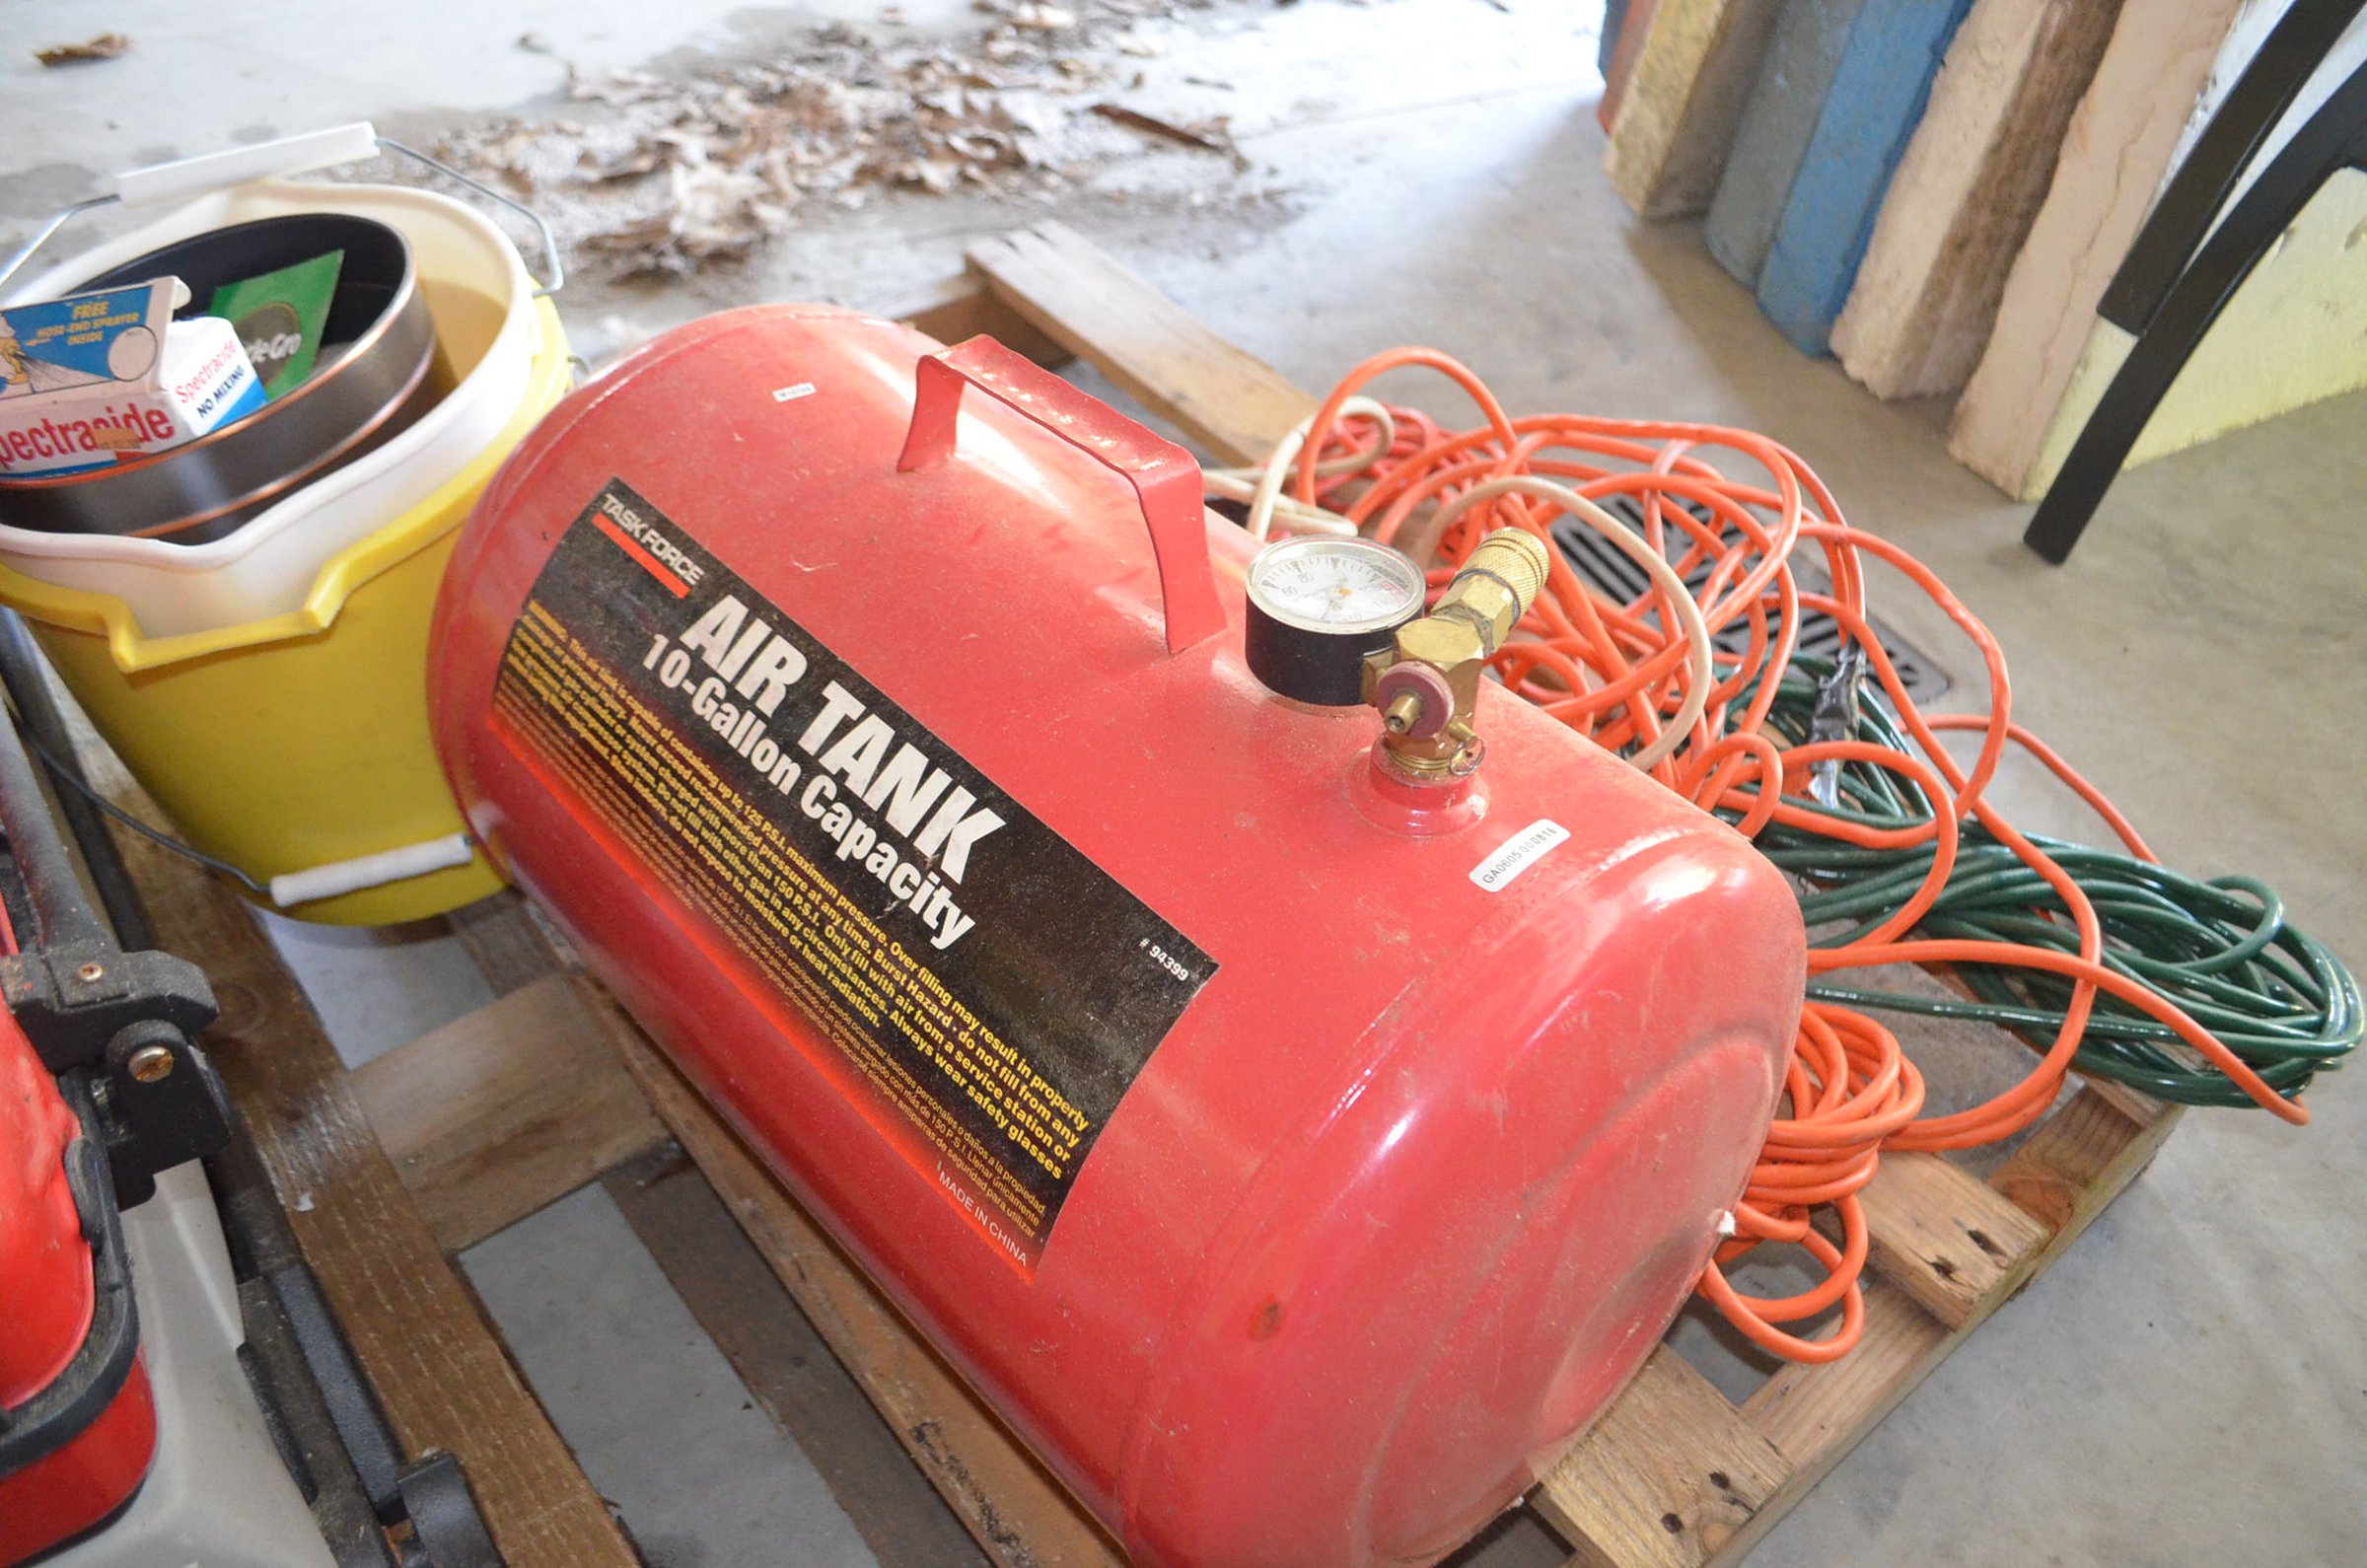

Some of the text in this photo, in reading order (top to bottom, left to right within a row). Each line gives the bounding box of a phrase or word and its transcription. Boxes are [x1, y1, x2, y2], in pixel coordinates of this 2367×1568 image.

[72, 301, 108, 320] FREE
[197, 365, 245, 419] NO MIXING
[601, 492, 705, 586] TASK FORCE
[642, 632, 802, 796] 10-Gallon
[800, 774, 976, 951] Capacity
[680, 594, 808, 719] AIR
[797, 679, 1007, 885] TANK
[668, 812, 683, 832] do
[681, 824, 699, 848] not
[695, 843, 733, 884] expose
[731, 875, 746, 893] to
[743, 887, 790, 938] moisture
[788, 933, 802, 950] or
[801, 943, 828, 974] heat
[826, 968, 884, 1029] radiation.
[668, 733, 721, 789] containing
[716, 780, 733, 802] up
[730, 791, 745, 811] to
[742, 802, 763, 827] 125
[760, 820, 787, 850] P.S.I.
[785, 843, 840, 899] maximum
[835, 892, 891, 950] pressure.
[889, 939, 919, 973] Over
[915, 965, 954, 1008] filling
[950, 999, 980, 1033] may
[978, 1023, 1019, 1066] result
[1016, 1058, 1034, 1080] in
[1029, 1071, 1090, 1135] property
[1482, 850, 1523, 885] GA0605
[654, 741, 692, 781] exceed
[688, 773, 762, 848] recommended
[758, 843, 809, 895] pressure
[807, 886, 823, 905] at
[819, 900, 843, 928] any
[841, 918, 875, 955] time.
[872, 948, 908, 986] Burst
[905, 979, 953, 1029] Hazard
[957, 1027, 977, 1051] do
[974, 1043, 1000, 1073] not
[997, 1065, 1020, 1092] fill
[1017, 1084, 1053, 1122] from
[1048, 1116, 1080, 1151] any
[656, 763, 699, 811] charged
[696, 802, 722, 830] with
[719, 824, 748, 856] more
[746, 849, 774, 881] than
[771, 874, 795, 900] 150
[792, 893, 823, 927] P.S.I.
[822, 923, 851, 958] Only
[849, 948, 869, 972] fill
[866, 964, 897, 998] with
[895, 991, 915, 1016] air
[912, 1009, 946, 1045] from
[943, 1040, 955, 1054] a
[953, 1047, 1005, 1102] service
[1002, 1094, 1054, 1149] station
[1051, 1144, 1070, 1165] or
[656, 781, 672, 802] Do
[669, 794, 688, 819] not
[685, 811, 702, 831] fill
[699, 824, 725, 853] with
[722, 845, 753, 881] other
[748, 875, 771, 901] gas
[769, 891, 784, 910] in
[779, 905, 803, 933] any
[801, 923, 891, 1015] circumstances.
[888, 1008, 935, 1059] Always
[933, 1052, 967, 1089] wear
[964, 1081, 1010, 1131] safety
[1006, 1121, 1064, 1182] glasses
[1149, 945, 1189, 982] 94399
[888, 1075, 904, 1093] con
[902, 1086, 922, 1109] más
[918, 1104, 932, 1120] de
[929, 1114, 947, 1134] 150
[966, 1150, 994, 1181] Llenar
[991, 1174, 1041, 1228] únicamente
[896, 1098, 937, 1143] antiparras
[934, 1136, 948, 1153] de
[945, 1147, 987, 1193] seguridad
[984, 1187, 1007, 1213] para
[1005, 1206, 1036, 1240] utilizar
[914, 1083, 959, 1131] personales
[957, 1126, 964, 1136] o
[963, 1129, 990, 1160] daños
[987, 1156, 995, 1166] a
[993, 1160, 1005, 1175] la
[937, 1170, 1030, 1267] MADE IN CHINA
